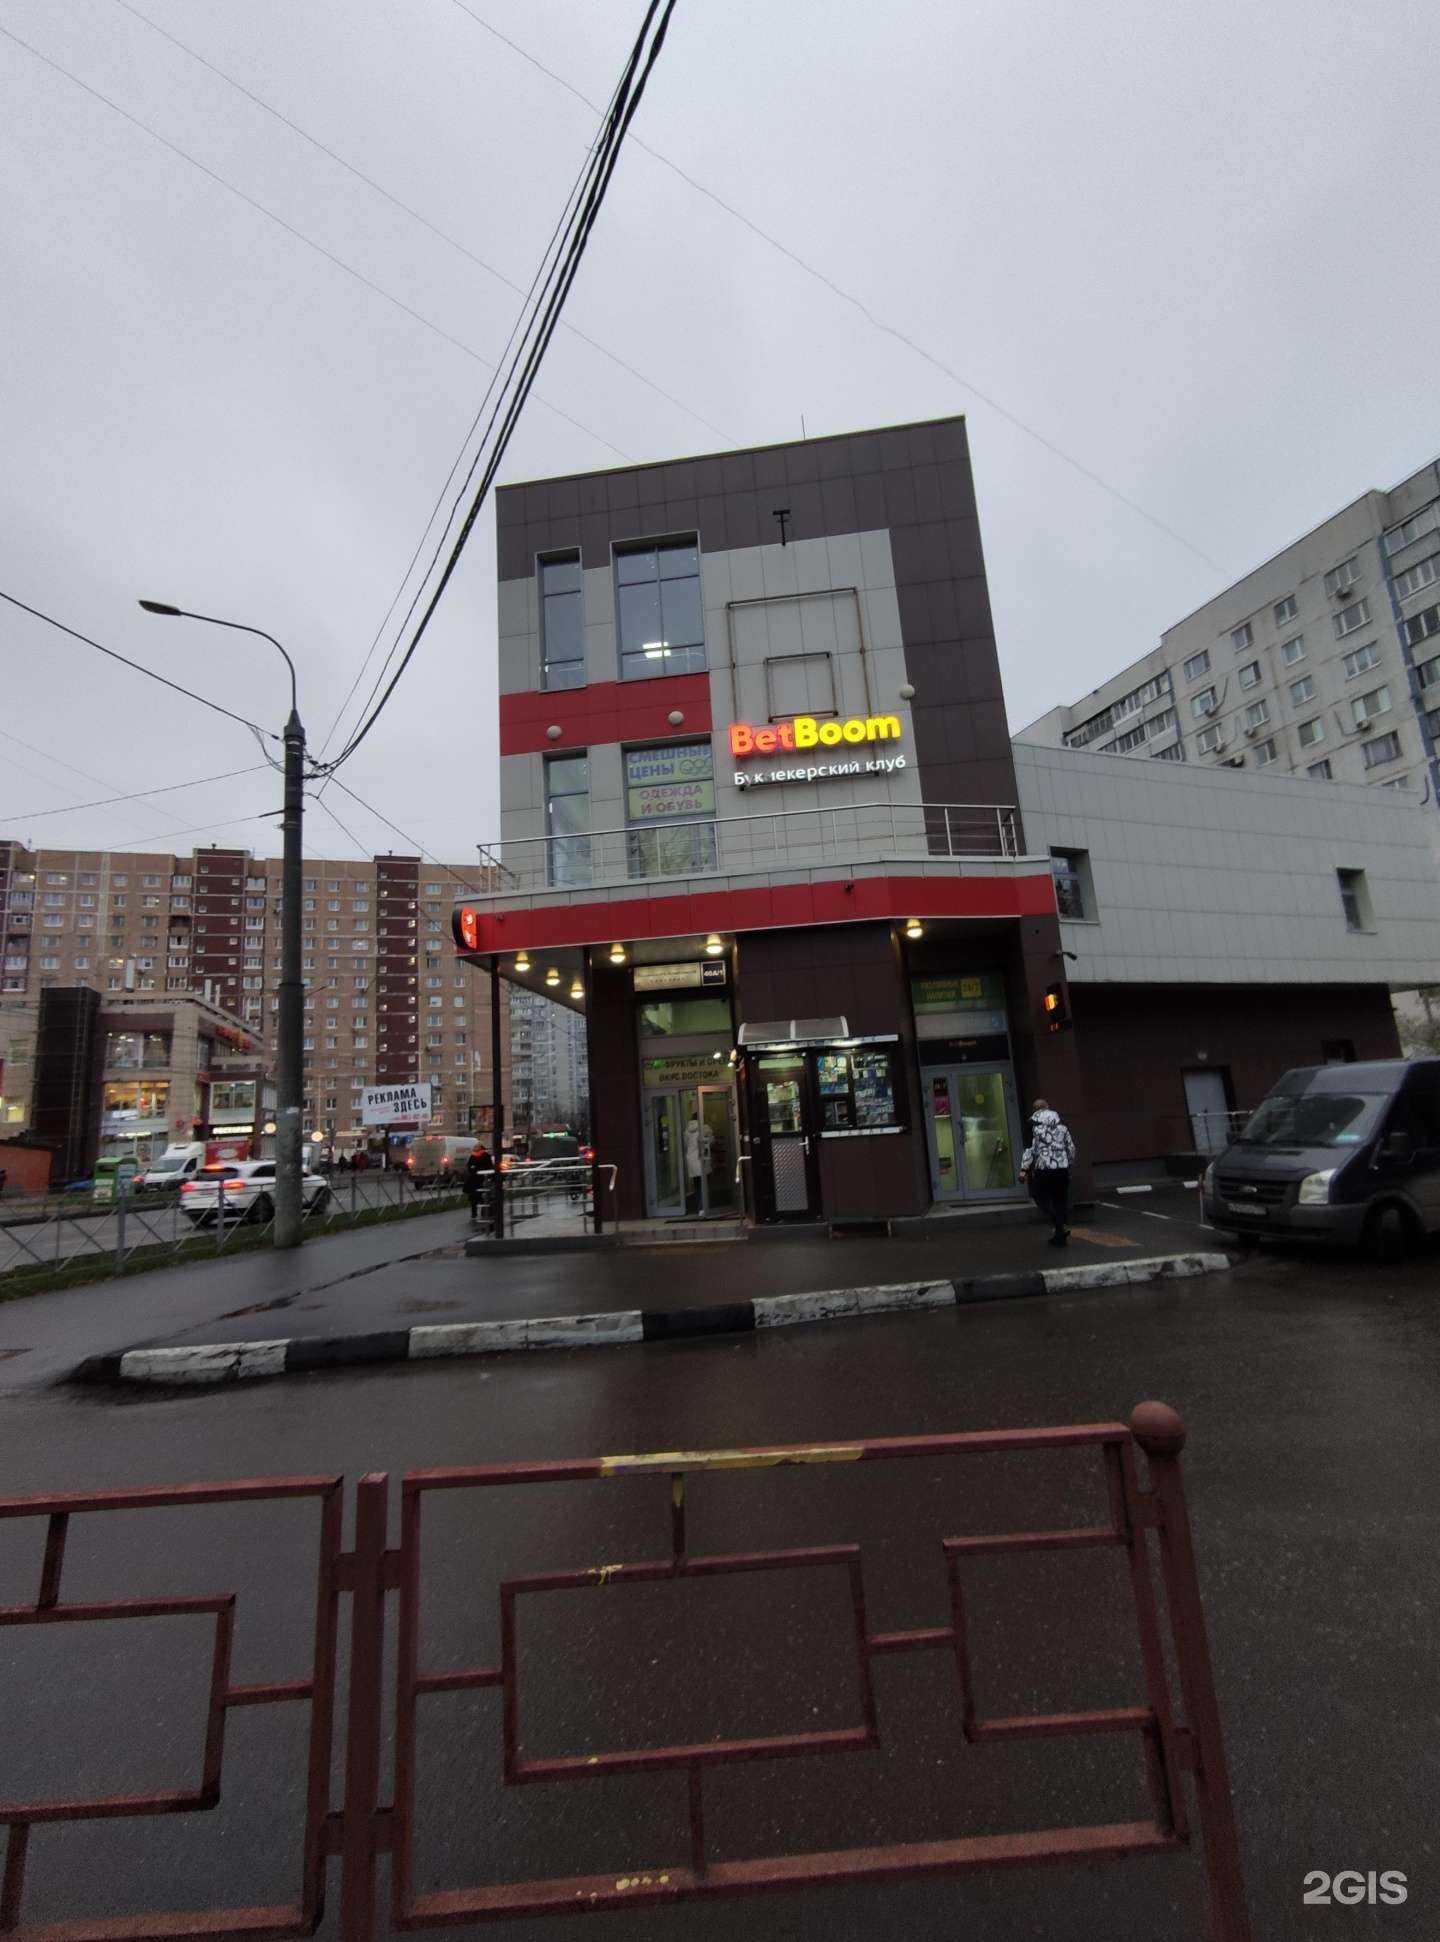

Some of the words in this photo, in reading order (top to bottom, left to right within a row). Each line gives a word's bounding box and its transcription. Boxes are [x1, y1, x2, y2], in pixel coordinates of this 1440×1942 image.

[731, 715, 902, 755] BetBoom
[629, 764, 674, 780] ЦЕНЫ
[865, 755, 907, 773] клуб
[640, 784, 703, 800] ОДЕЖДА
[641, 803, 651, 815] И
[655, 800, 703, 813] ОБУВЬ
[682, 1070, 720, 1080] ВОСТОКА
[367, 1087, 417, 1105] РЕКЛАМА
[393, 1097, 428, 1113] ЗДЕСЬ
